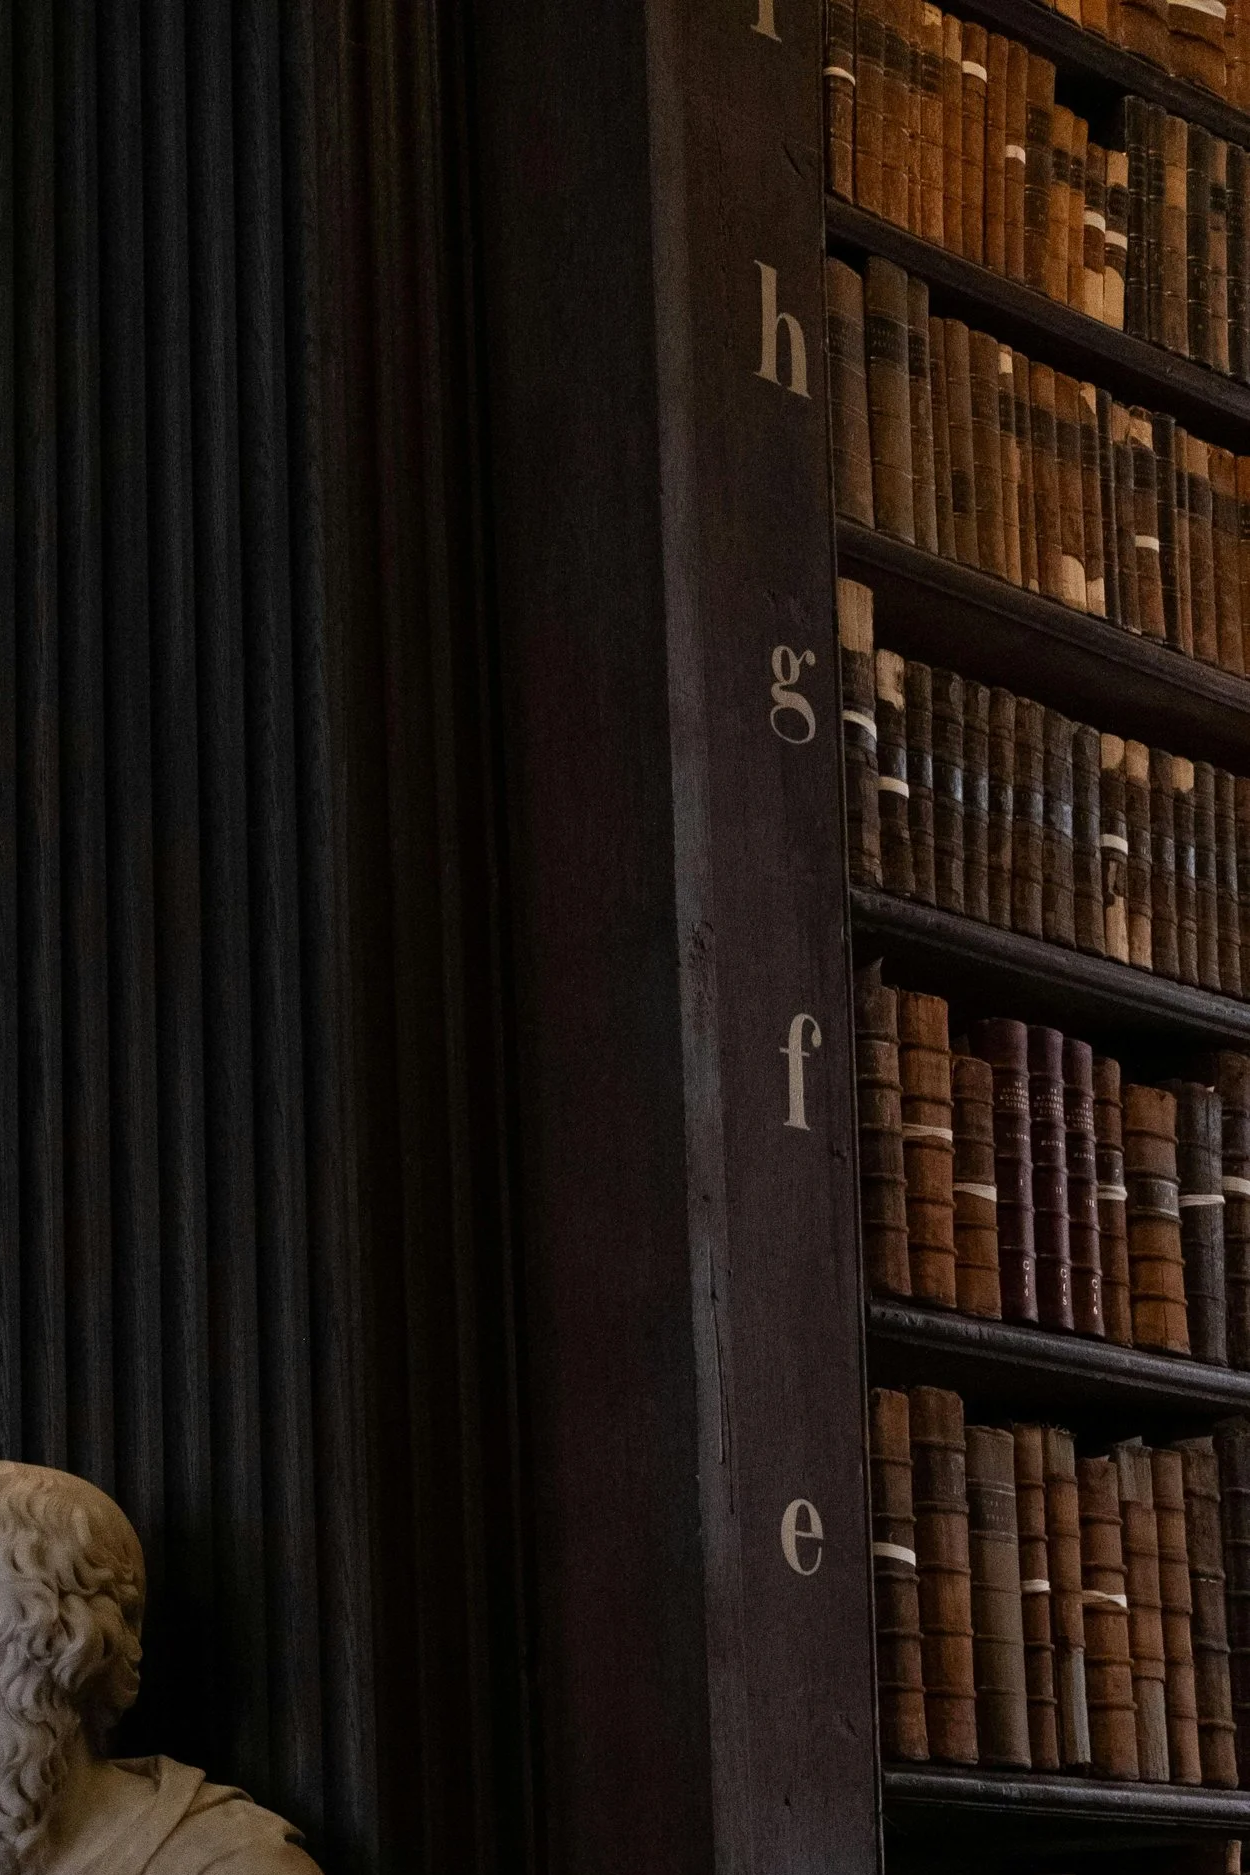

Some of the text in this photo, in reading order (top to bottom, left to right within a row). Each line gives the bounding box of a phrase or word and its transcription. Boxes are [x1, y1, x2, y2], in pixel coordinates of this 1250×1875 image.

[754, 260, 812, 399] h
[769, 645, 816, 744] g
[779, 1013, 822, 1131] f
[780, 1498, 824, 1576] e
